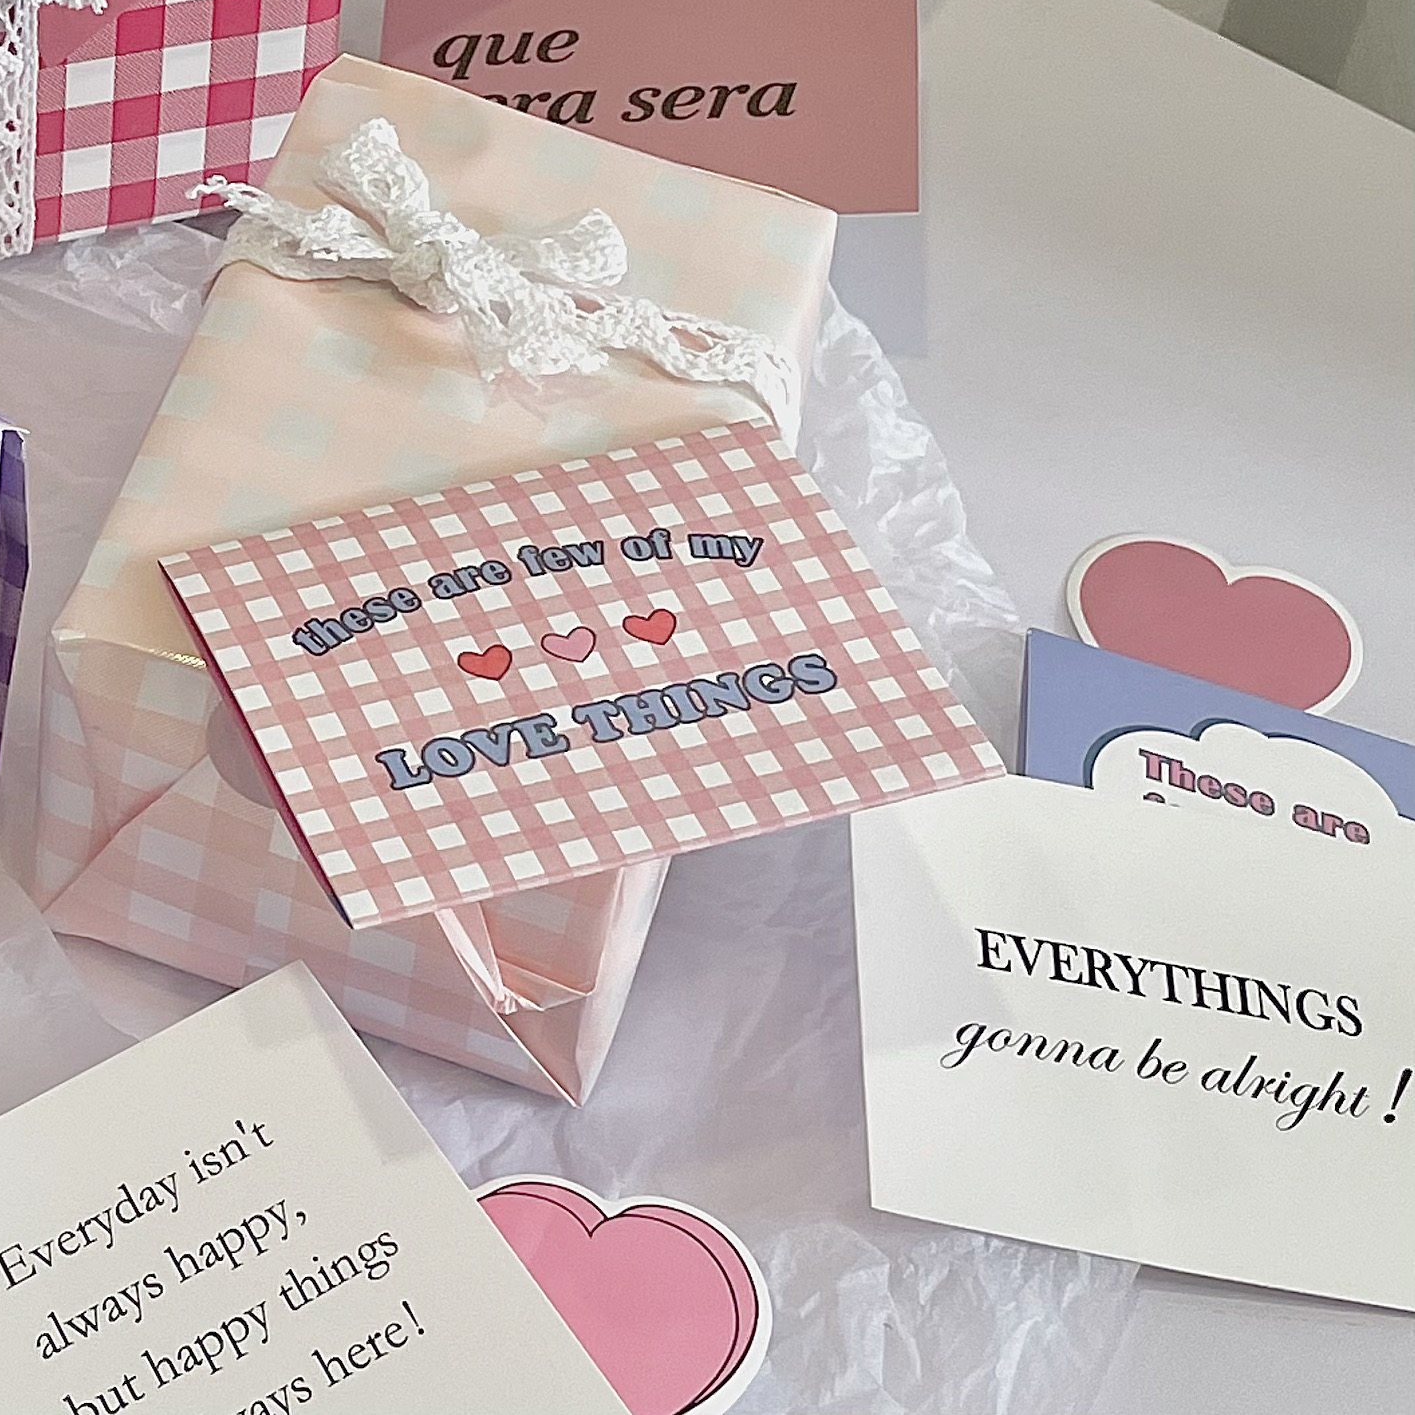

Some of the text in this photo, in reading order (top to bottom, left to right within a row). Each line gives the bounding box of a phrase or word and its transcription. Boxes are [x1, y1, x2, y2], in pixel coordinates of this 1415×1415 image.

[433, 28, 579, 79] que
[483, 81, 797, 125] ra sera
[292, 528, 763, 656] these are few of my
[376, 654, 837, 790] LOVE THINGS
[1139, 748, 1371, 845] These are
[974, 928, 1364, 1037] EVERYTHINGS
[940, 1021, 1125, 1069] gonna
[1136, 1038, 1190, 1085] be
[1200, 1055, 1370, 1131] alright
[184, 1119, 274, 1184] isn't
[34, 1198, 308, 1360] always happy,
[141, 1301, 267, 1389] happy
[279, 1231, 400, 1312] things
[311, 1300, 425, 1388] here!
